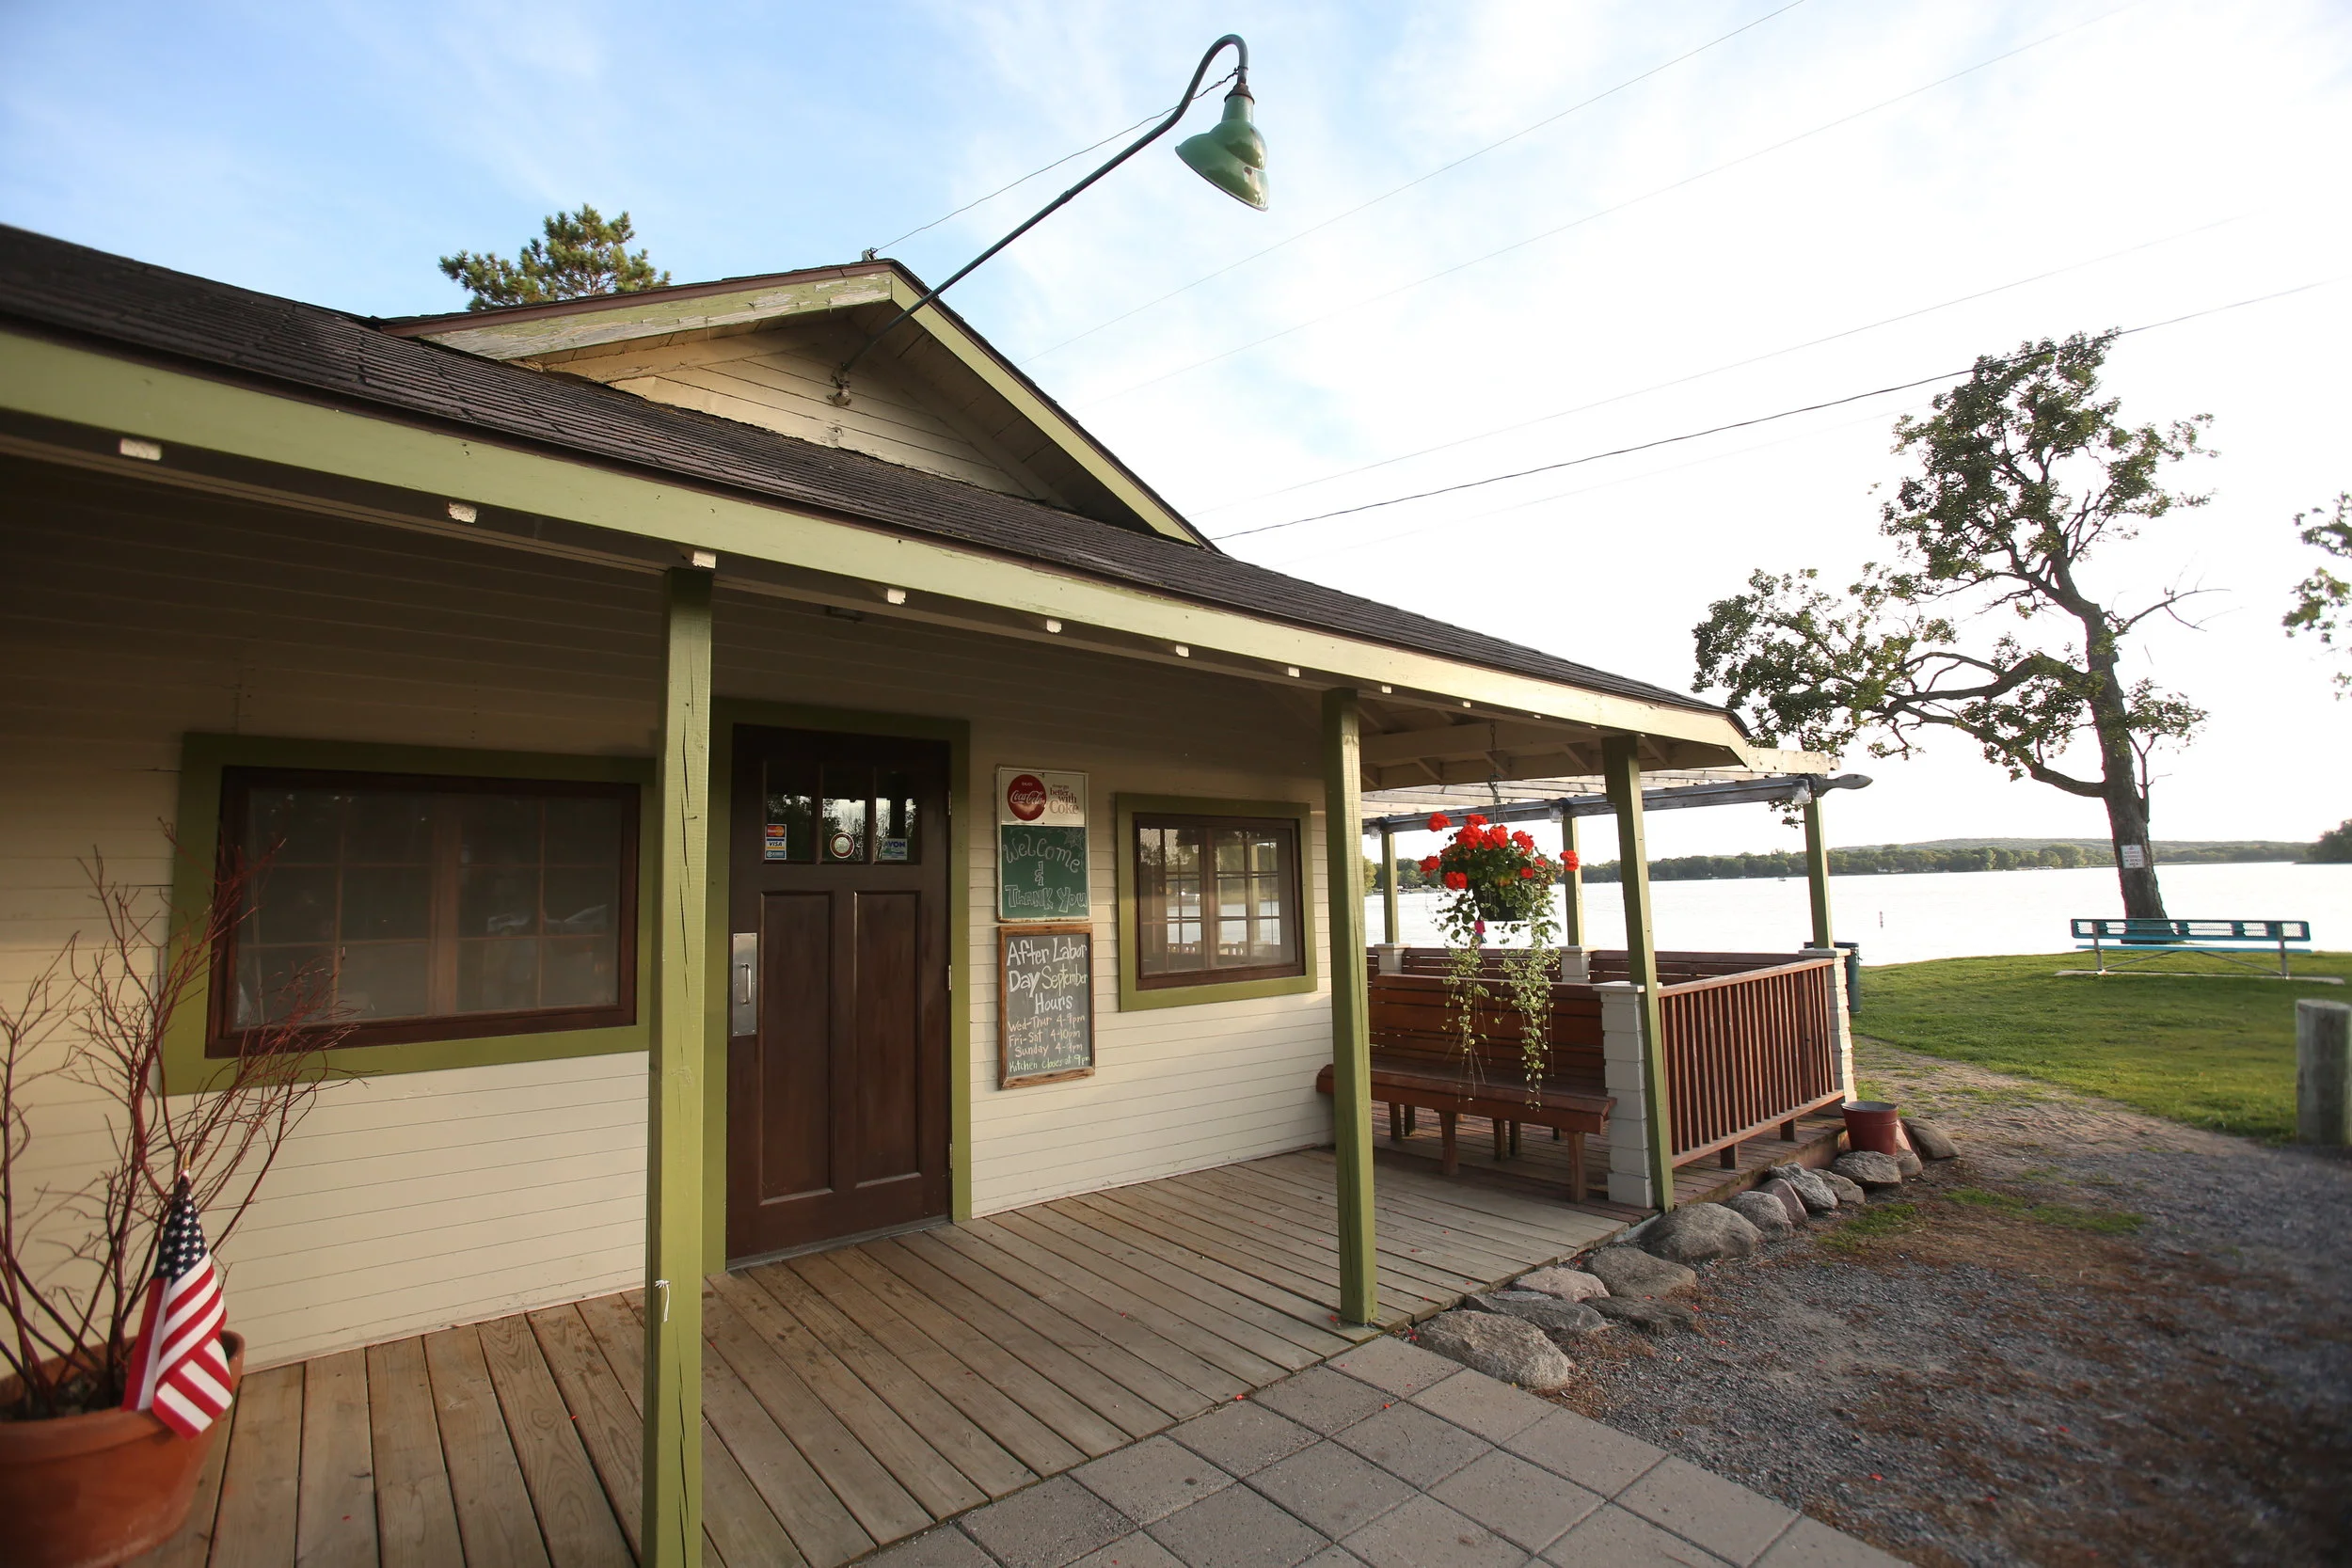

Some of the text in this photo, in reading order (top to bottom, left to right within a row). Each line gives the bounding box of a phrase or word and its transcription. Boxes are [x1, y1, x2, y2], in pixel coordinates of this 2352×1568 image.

[1058, 793, 1077, 803] with
[1049, 799, 1079, 815] Coke
[1007, 937, 1088, 966] After Labor
[1009, 963, 1088, 998] Day September
[1035, 992, 1073, 1014] Hours
[1009, 1029, 1043, 1048] Fri-Sat
[1014, 1044, 1049, 1057] Sunday
[1009, 1060, 1038, 1072] Kitchen
